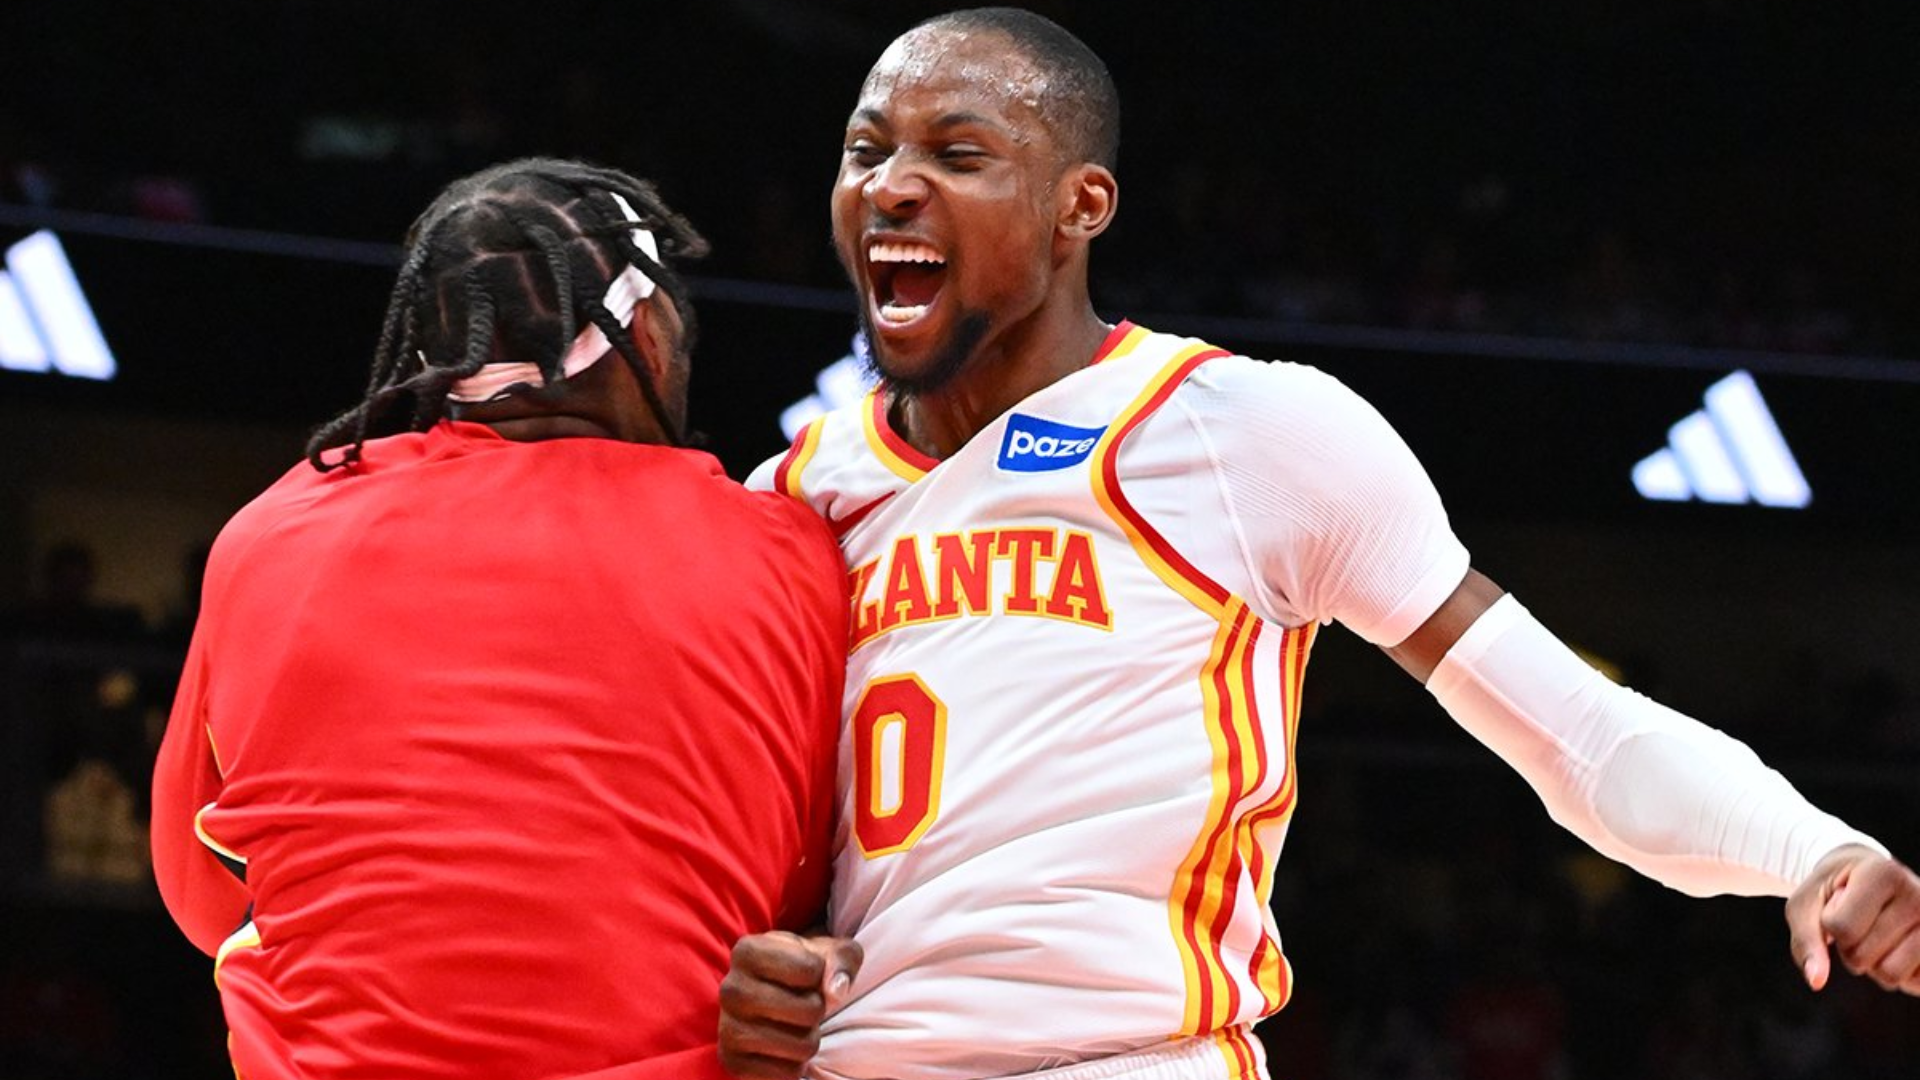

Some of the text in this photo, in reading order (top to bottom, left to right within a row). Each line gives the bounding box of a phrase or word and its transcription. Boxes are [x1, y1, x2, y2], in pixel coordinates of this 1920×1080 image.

[1006, 429, 1096, 459] paze
[849, 526, 1113, 656] LANTA
[853, 671, 948, 861] 0
